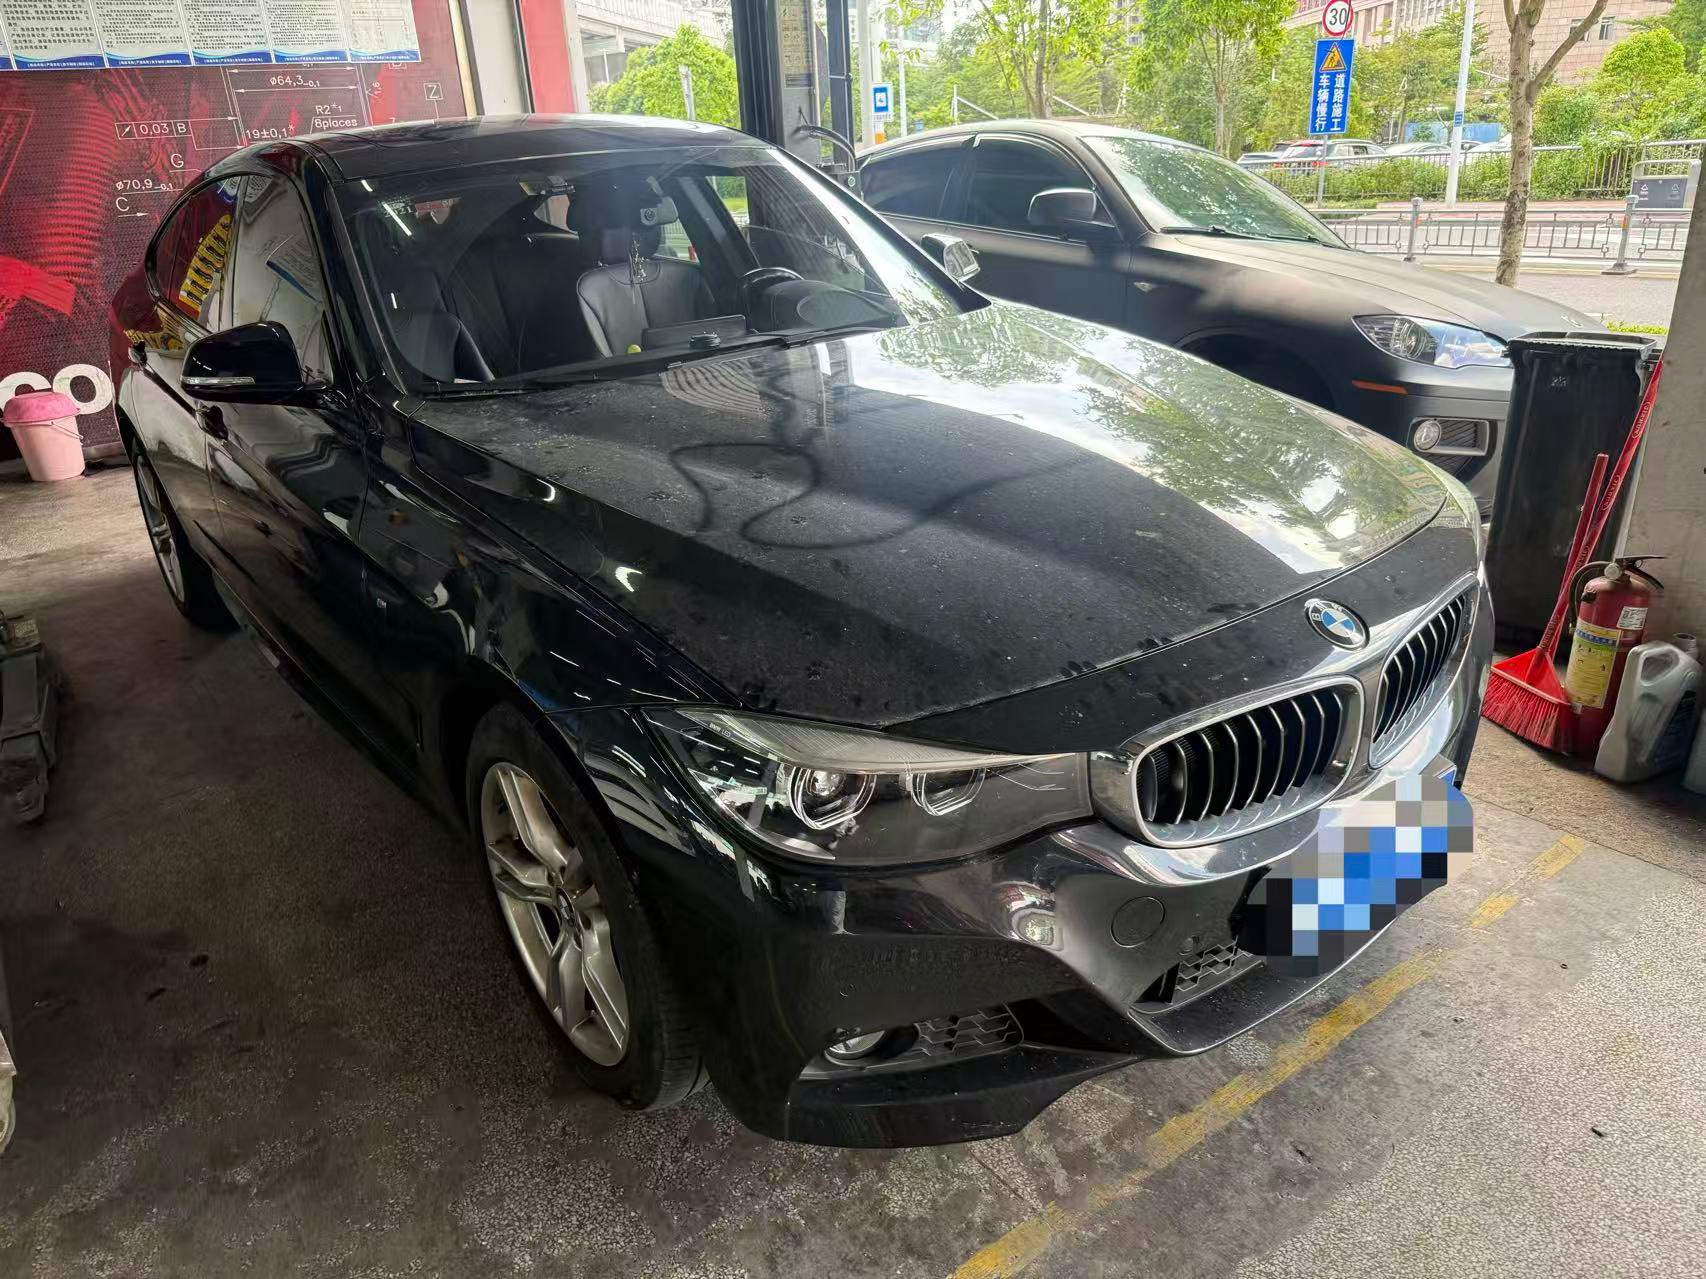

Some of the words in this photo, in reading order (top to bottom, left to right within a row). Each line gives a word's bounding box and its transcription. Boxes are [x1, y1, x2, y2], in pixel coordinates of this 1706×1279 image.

[1329, 7, 1348, 26] 30
[428, 84, 440, 99] Z
[1315, 73, 1331, 132] 车辆慢行
[1330, 73, 1346, 132] 道路施工
[139, 124, 170, 135] 0,03
[177, 123, 187, 133] B
[314, 117, 358, 130] 8places
[170, 153, 185, 168] G
[115, 197, 130, 212] C
